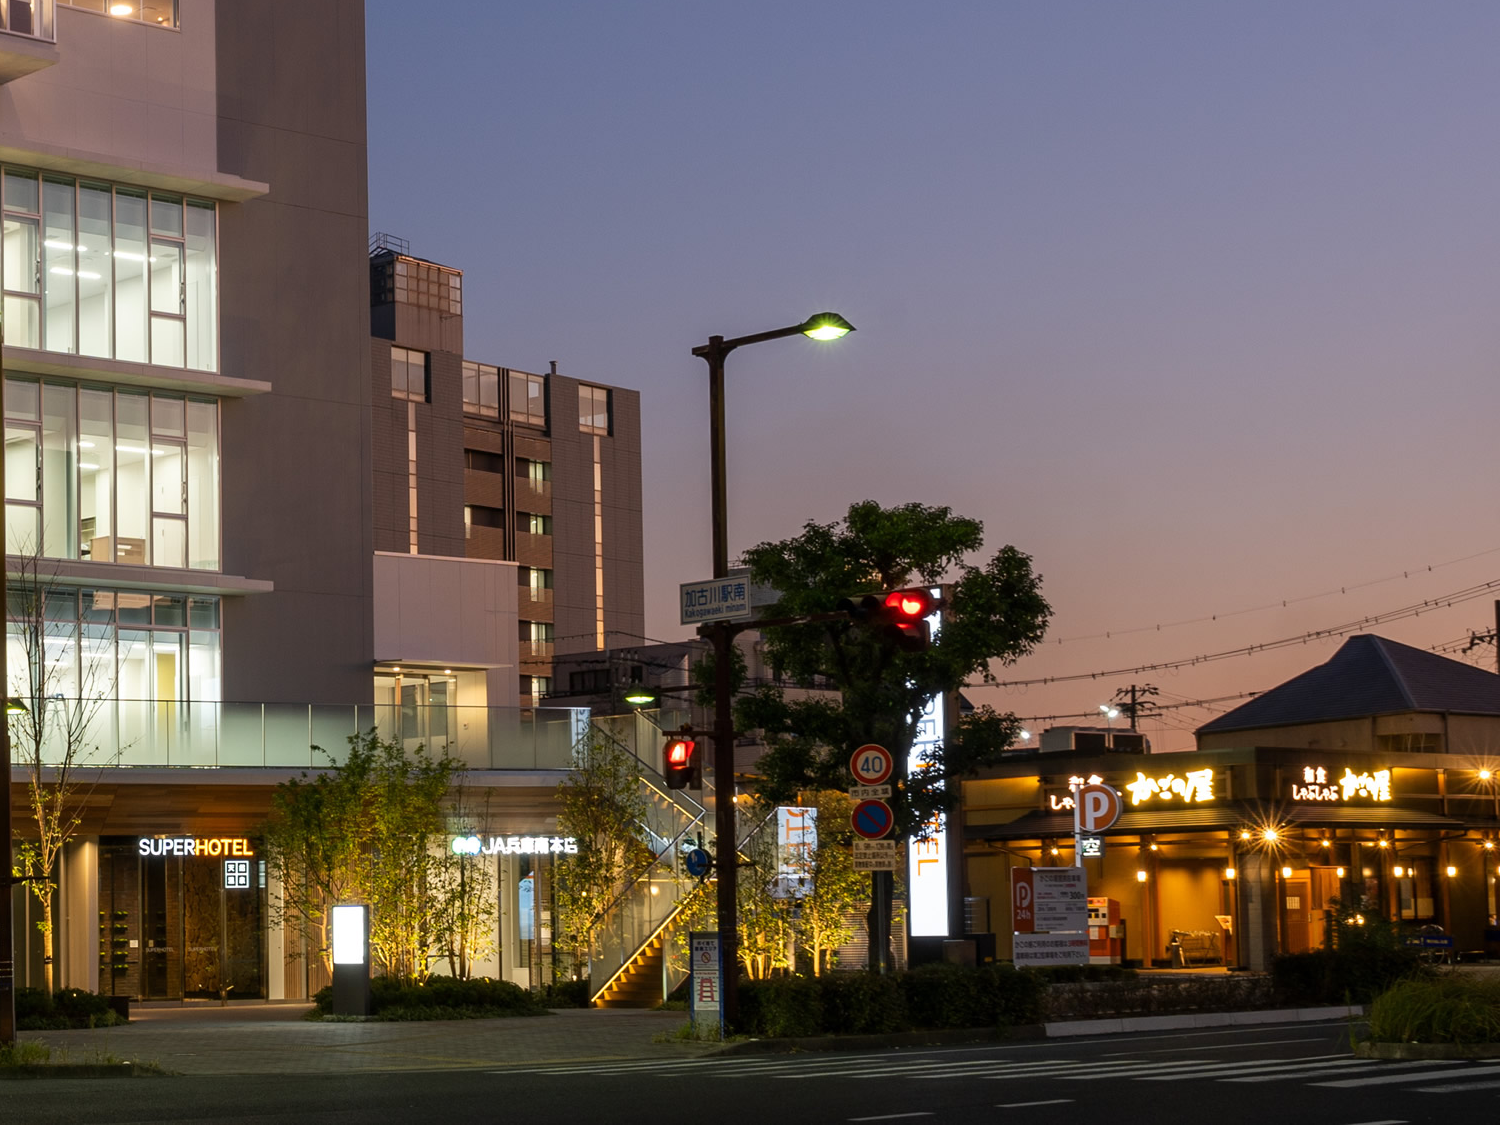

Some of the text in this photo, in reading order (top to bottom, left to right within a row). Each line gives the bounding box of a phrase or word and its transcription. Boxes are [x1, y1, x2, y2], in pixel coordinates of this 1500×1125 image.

[685, 583, 746, 608] 加古川駅南
[861, 756, 883, 773] 40
[1126, 768, 1216, 806] かごの屋
[1085, 791, 1109, 830] P
[1082, 838, 1101, 856] 空
[1016, 909, 1031, 920] 24h
